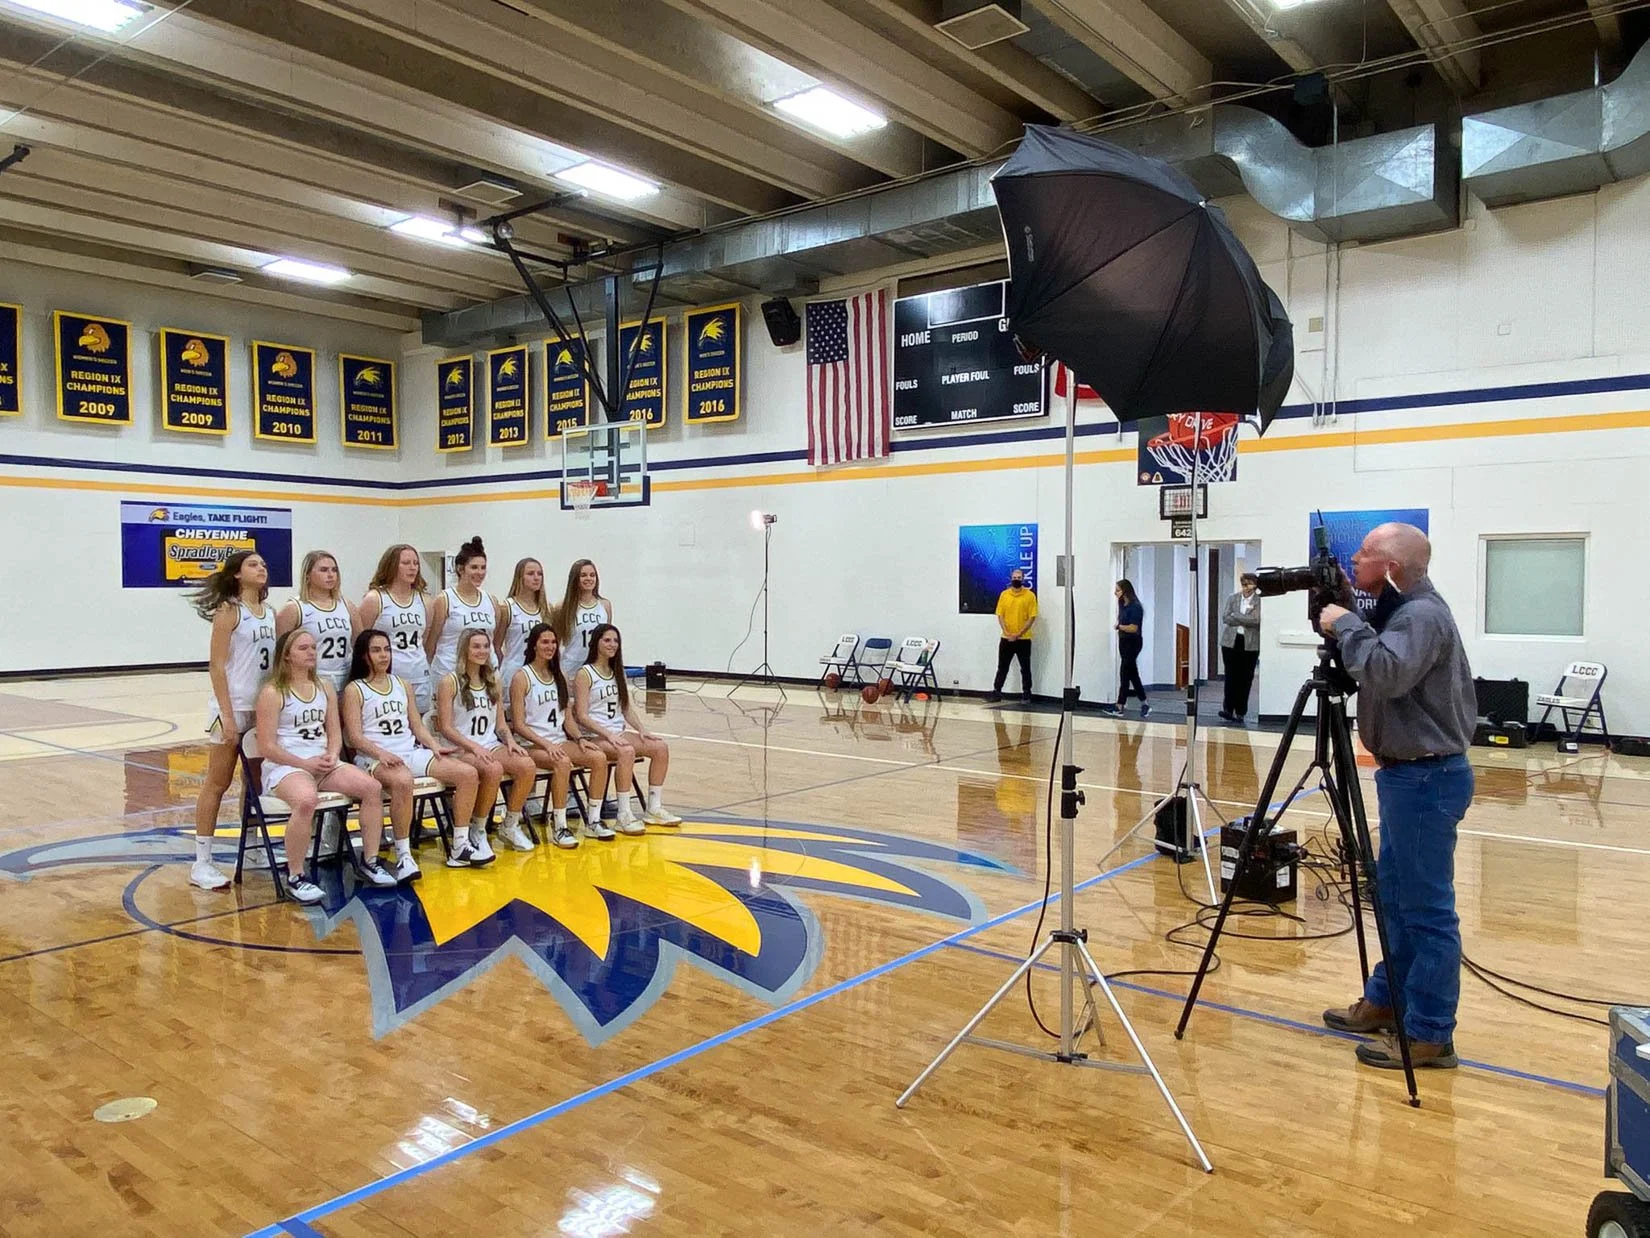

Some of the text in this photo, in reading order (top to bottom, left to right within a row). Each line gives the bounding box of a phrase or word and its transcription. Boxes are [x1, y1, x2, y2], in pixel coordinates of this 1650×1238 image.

[901, 330, 931, 348] HOME
[952, 332, 978, 344] PERIOD
[694, 367, 730, 380] REGION IX
[1014, 364, 1040, 376] FOULS
[71, 370, 121, 384] REGION IX
[629, 378, 649, 388] EGION
[941, 370, 990, 385] PLAYER FOUL
[66, 382, 126, 395] CHAMPIONS
[174, 384, 218, 395] REGION IX
[691, 379, 734, 392] CHAMPIONS
[896, 379, 918, 390] FOULS
[170, 394, 222, 406] CHAMPIONS
[266, 394, 306, 405] REGION IX
[552, 390, 573, 400] REGION
[626, 388, 661, 400] HAMPIONS
[79, 401, 115, 416] 2009
[262, 404, 311, 417] CHAMPIONS
[351, 404, 378, 413] REGION
[550, 399, 583, 412] CHAMPIONS
[700, 400, 725, 414] 2016
[1013, 403, 1039, 414] SCORE
[182, 412, 213, 426] 2009
[348, 414, 391, 424] CHAMPIONS
[493, 409, 524, 420] CHAMPIONS
[630, 408, 654, 421] 2016
[895, 415, 918, 426] SCORE
[951, 409, 977, 420] MATCH
[272, 422, 302, 435] 2010
[557, 418, 577, 431] 2015
[357, 430, 382, 442] 2011
[447, 433, 465, 445] 2012
[499, 426, 519, 439] 2013
[173, 512, 268, 524] Eagles, TAKE FLIGHT!
[175, 529, 248, 541] CHEYENNE
[1020, 526, 1033, 547] UP
[392, 613, 422, 628] LCCC
[463, 612, 492, 626] LCCC
[318, 618, 350, 634] LCCC
[395, 630, 419, 650] 34
[322, 636, 347, 659] 23
[260, 648, 269, 670] 3
[1572, 665, 1598, 676] LCCC
[538, 690, 557, 706] LCC
[600, 685, 618, 700] LCC
[375, 700, 403, 719] LCCC
[607, 702, 616, 720] 5
[294, 708, 325, 728] LCCC
[548, 708, 557, 727] 4
[378, 719, 404, 736] 32
[471, 716, 488, 736] 10
